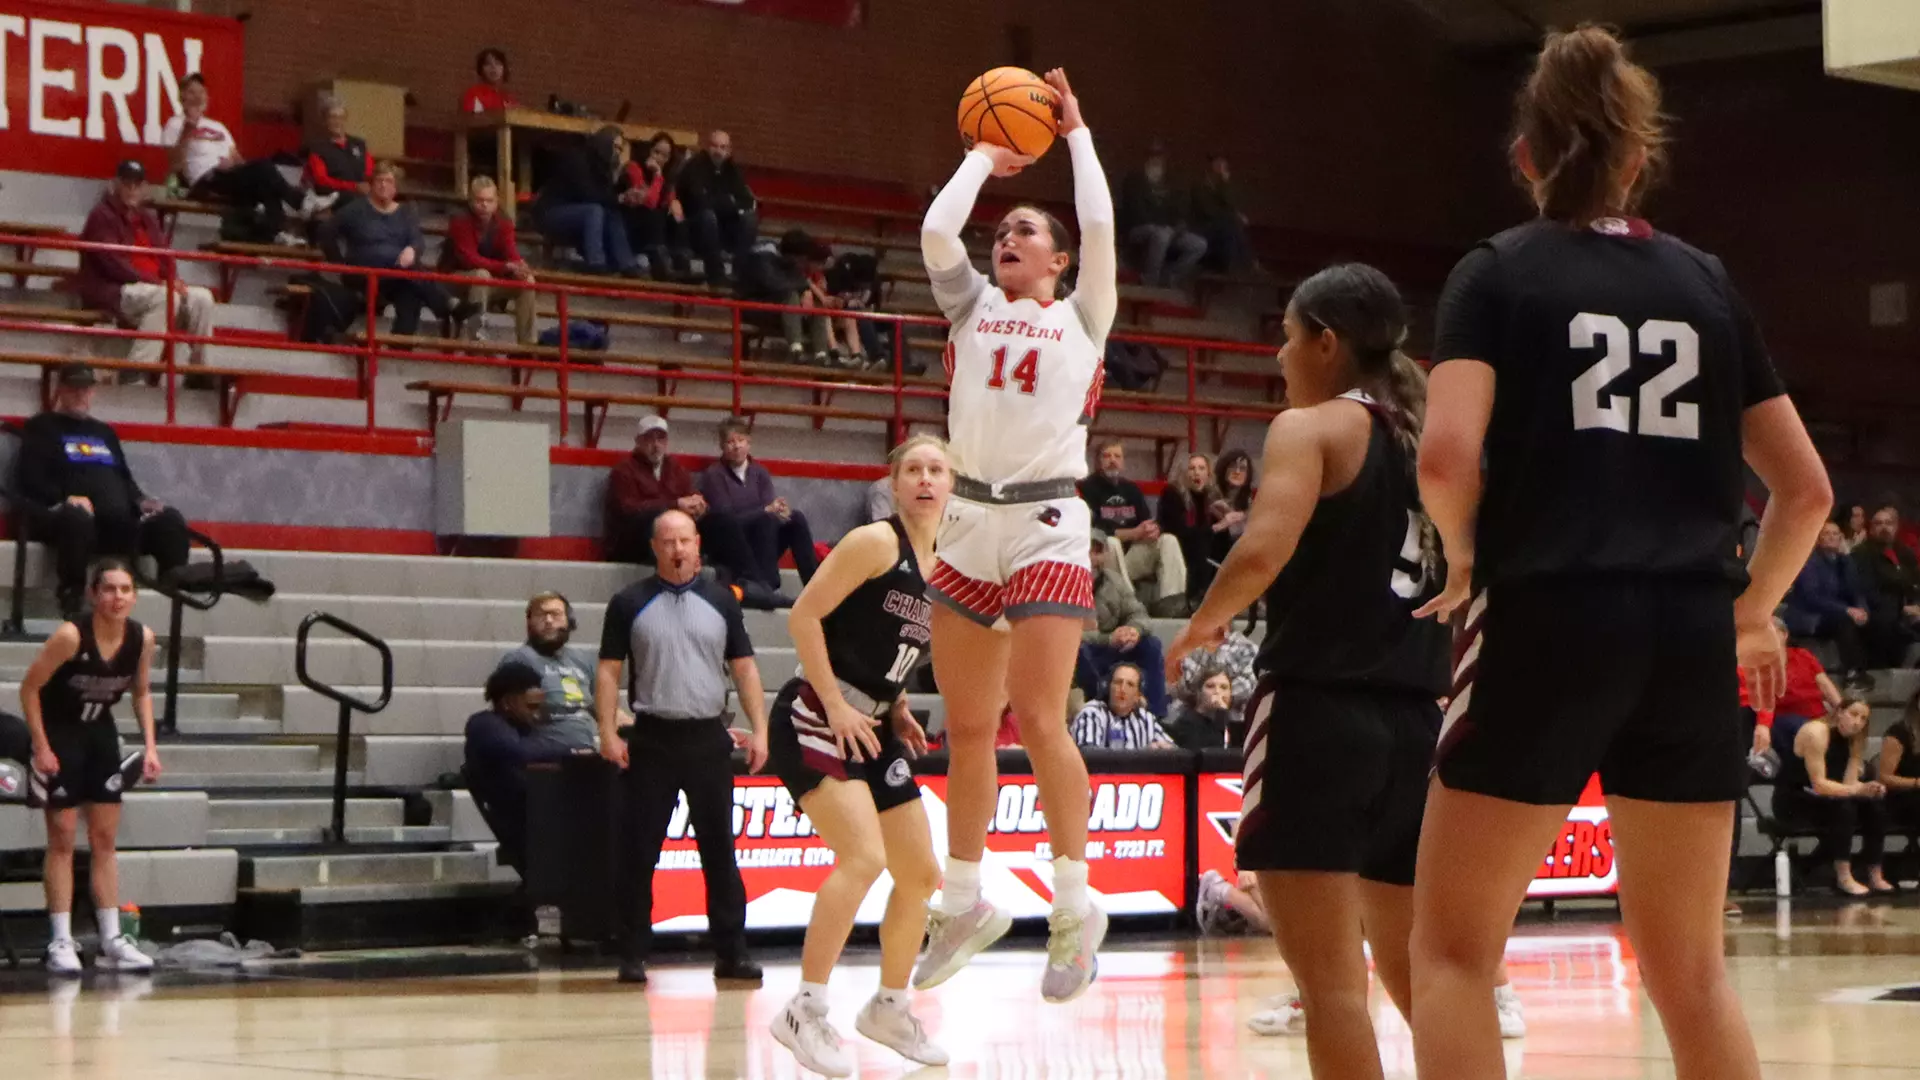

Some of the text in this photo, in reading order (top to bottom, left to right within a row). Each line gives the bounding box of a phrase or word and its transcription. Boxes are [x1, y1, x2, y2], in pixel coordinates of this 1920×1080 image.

[976, 318, 1064, 342] WESTERN
[985, 344, 1041, 396] 14
[1569, 312, 1699, 440] 22
[883, 589, 932, 627] CHAD
[885, 643, 920, 683] 10
[80, 702, 104, 722] 11
[986, 782, 1165, 833] OLADO
